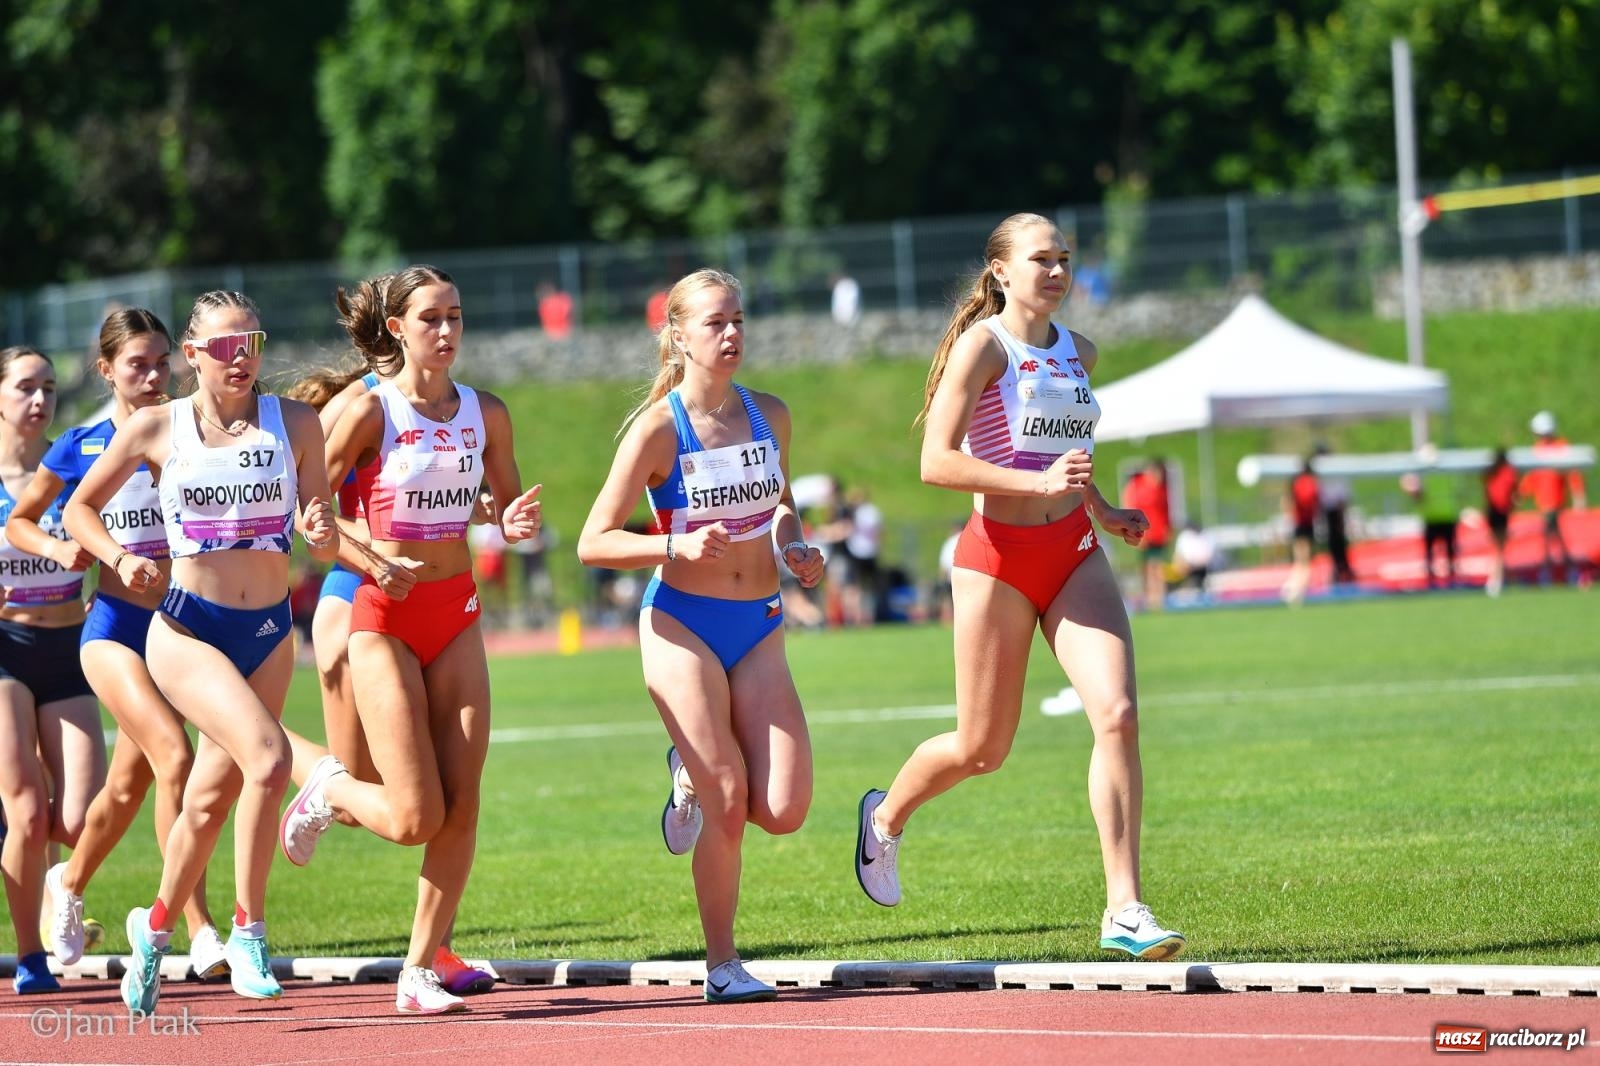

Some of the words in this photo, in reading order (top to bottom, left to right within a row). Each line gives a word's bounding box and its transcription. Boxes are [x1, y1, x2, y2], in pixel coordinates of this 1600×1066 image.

[1075, 386, 1091, 405] 18
[1022, 414, 1093, 440] LEMAŃSKA
[239, 449, 275, 468] 317
[433, 444, 457, 452] ORLEN
[740, 446, 767, 468] 117
[458, 454, 474, 474] 17
[183, 478, 283, 506] POPOVICOVÁ
[405, 486, 478, 510] THAMM
[691, 473, 781, 510] ŠTEFANOVÁ
[102, 507, 165, 531] DUBEN
[255, 626, 280, 638] adidas
